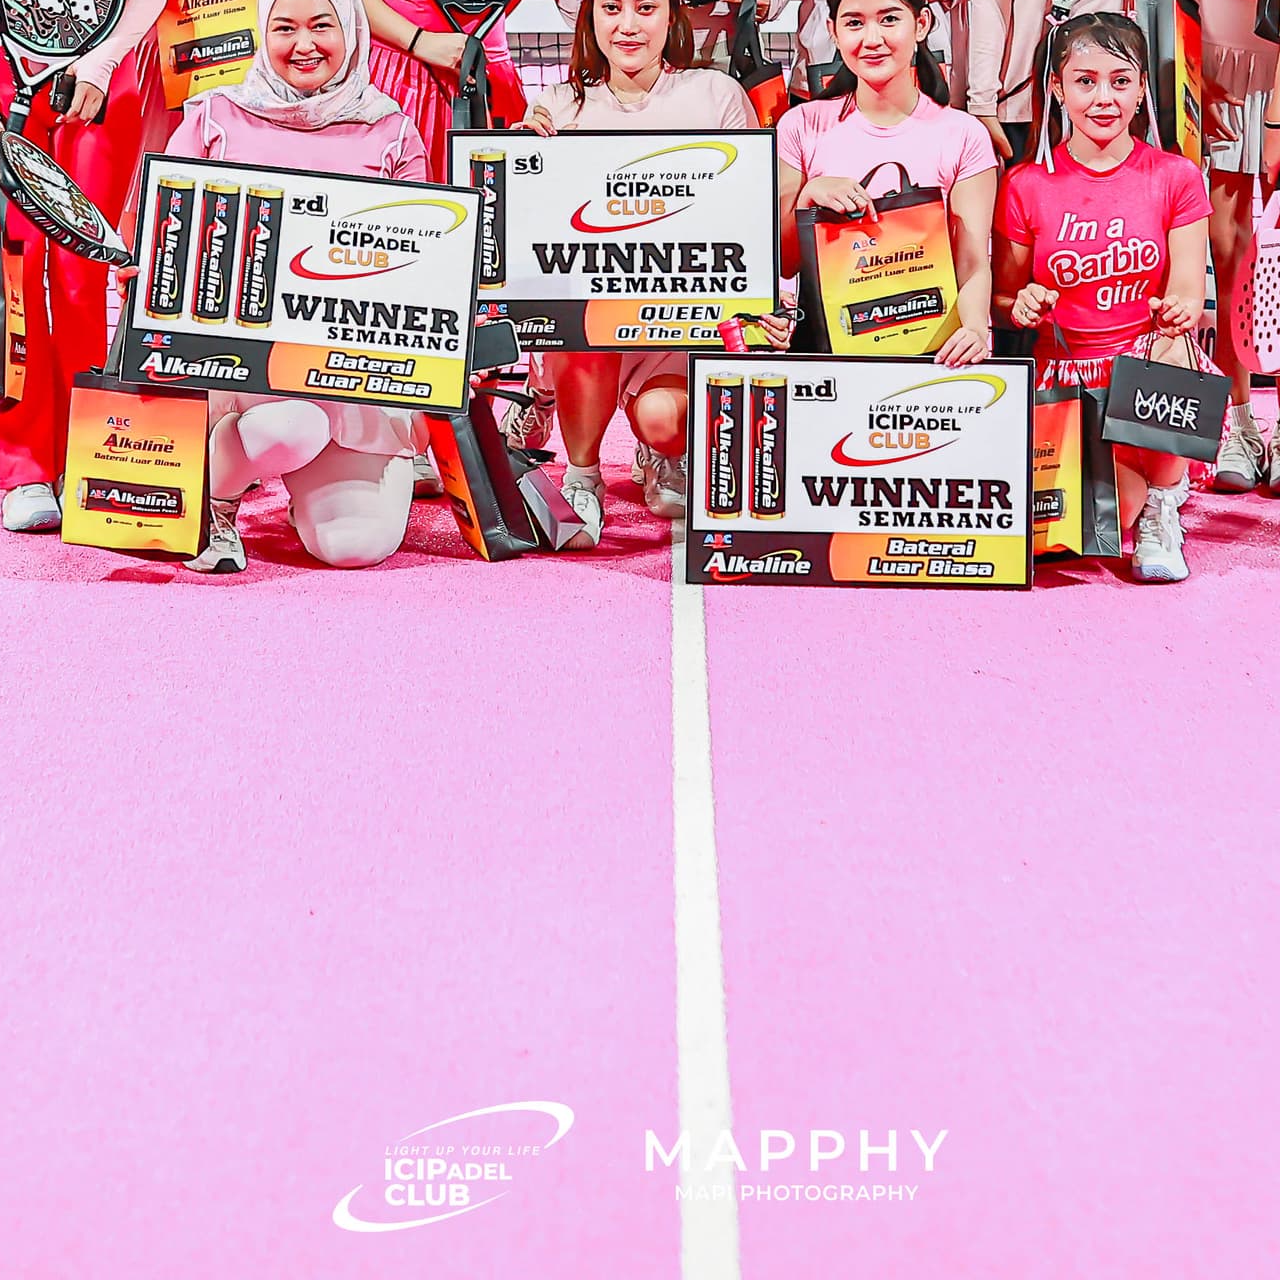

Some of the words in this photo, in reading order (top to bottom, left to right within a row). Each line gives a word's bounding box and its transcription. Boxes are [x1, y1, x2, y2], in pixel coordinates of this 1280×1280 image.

[190, 40, 250, 60] Alkaline
[514, 152, 541, 172] st
[606, 173, 638, 181] LIGHT
[641, 173, 656, 181] UP
[659, 172, 687, 181] YOUR
[691, 172, 714, 180] LIFE
[291, 195, 326, 215] rd
[606, 200, 666, 216] CLUB
[331, 219, 365, 230] LIGHT
[367, 223, 383, 232] UP
[385, 225, 414, 235] YOUR
[418, 229, 442, 239] LIFE
[483, 185, 497, 278] Alkaline
[1057, 213, 1097, 241] I'm
[1106, 218, 1124, 238] a
[159, 212, 182, 308] Alkaline
[204, 216, 228, 313] Alkaline
[328, 246, 389, 268] CLUB
[532, 242, 747, 274] WINNER
[855, 250, 924, 270] Alkaline
[1048, 238, 1159, 288] Barbie
[248, 221, 271, 317] Alkaline
[590, 276, 748, 294] SEMARANG
[282, 293, 459, 336] WINNER
[639, 304, 721, 321] QUEEN
[869, 297, 937, 321] Alkaline
[327, 326, 459, 352] SEMARANG
[616, 326, 640, 340] Of
[646, 325, 683, 340] The
[139, 351, 249, 381] Alkaline
[326, 350, 415, 376] Baterai
[307, 371, 362, 392] Luar
[364, 375, 432, 398] Biasa
[794, 379, 834, 399] nd
[869, 404, 903, 413] LIGHT
[906, 405, 921, 413] UP
[924, 405, 954, 414] YOUR
[957, 406, 982, 414] LIFE
[1135, 389, 1200, 413] MAKE
[106, 416, 131, 428] ABC
[1135, 402, 1197, 430] OVER
[102, 433, 175, 454] Alkaline
[868, 432, 930, 449] CLUB
[718, 410, 734, 508] Alkaline
[762, 411, 778, 508] Alkaline
[105, 488, 178, 508] Alkaline
[802, 476, 1013, 510] WINNER
[858, 511, 1014, 529] SEMARANG
[887, 538, 975, 557] Baterai
[702, 553, 812, 574] Alkaline
[868, 558, 922, 575] Luar
[928, 558, 994, 578] Biasa
